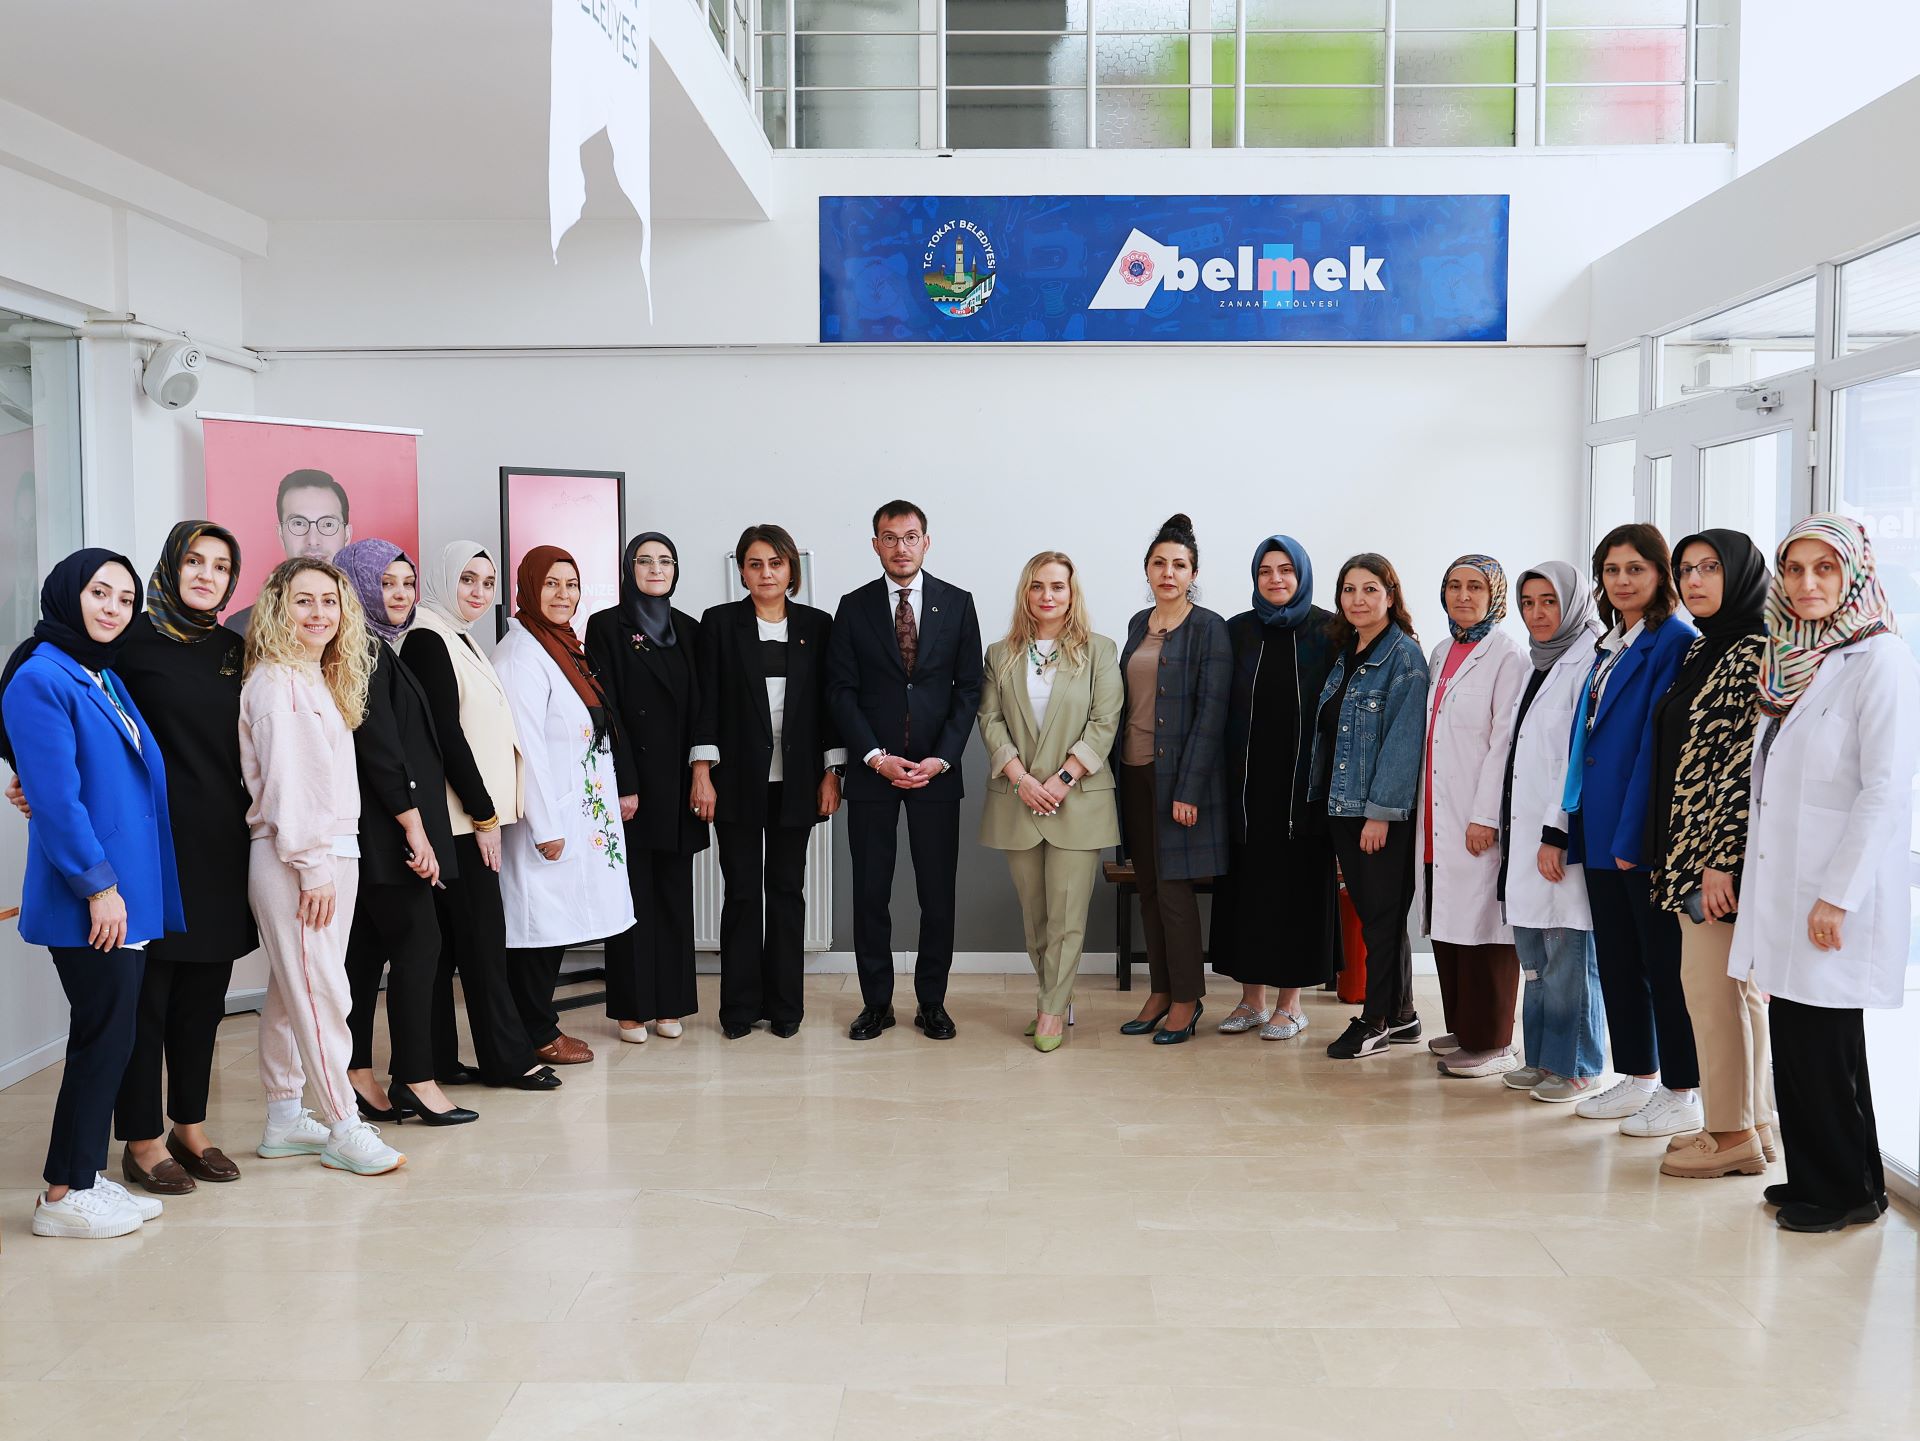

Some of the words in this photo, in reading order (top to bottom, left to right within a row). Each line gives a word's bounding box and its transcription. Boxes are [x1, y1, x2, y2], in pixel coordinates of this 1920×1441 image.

[927, 220, 956, 249] TOKAT
[923, 251, 934, 269] T.C.
[1163, 245, 1386, 293] belmek
[1219, 300, 1268, 308] ZANAAT
